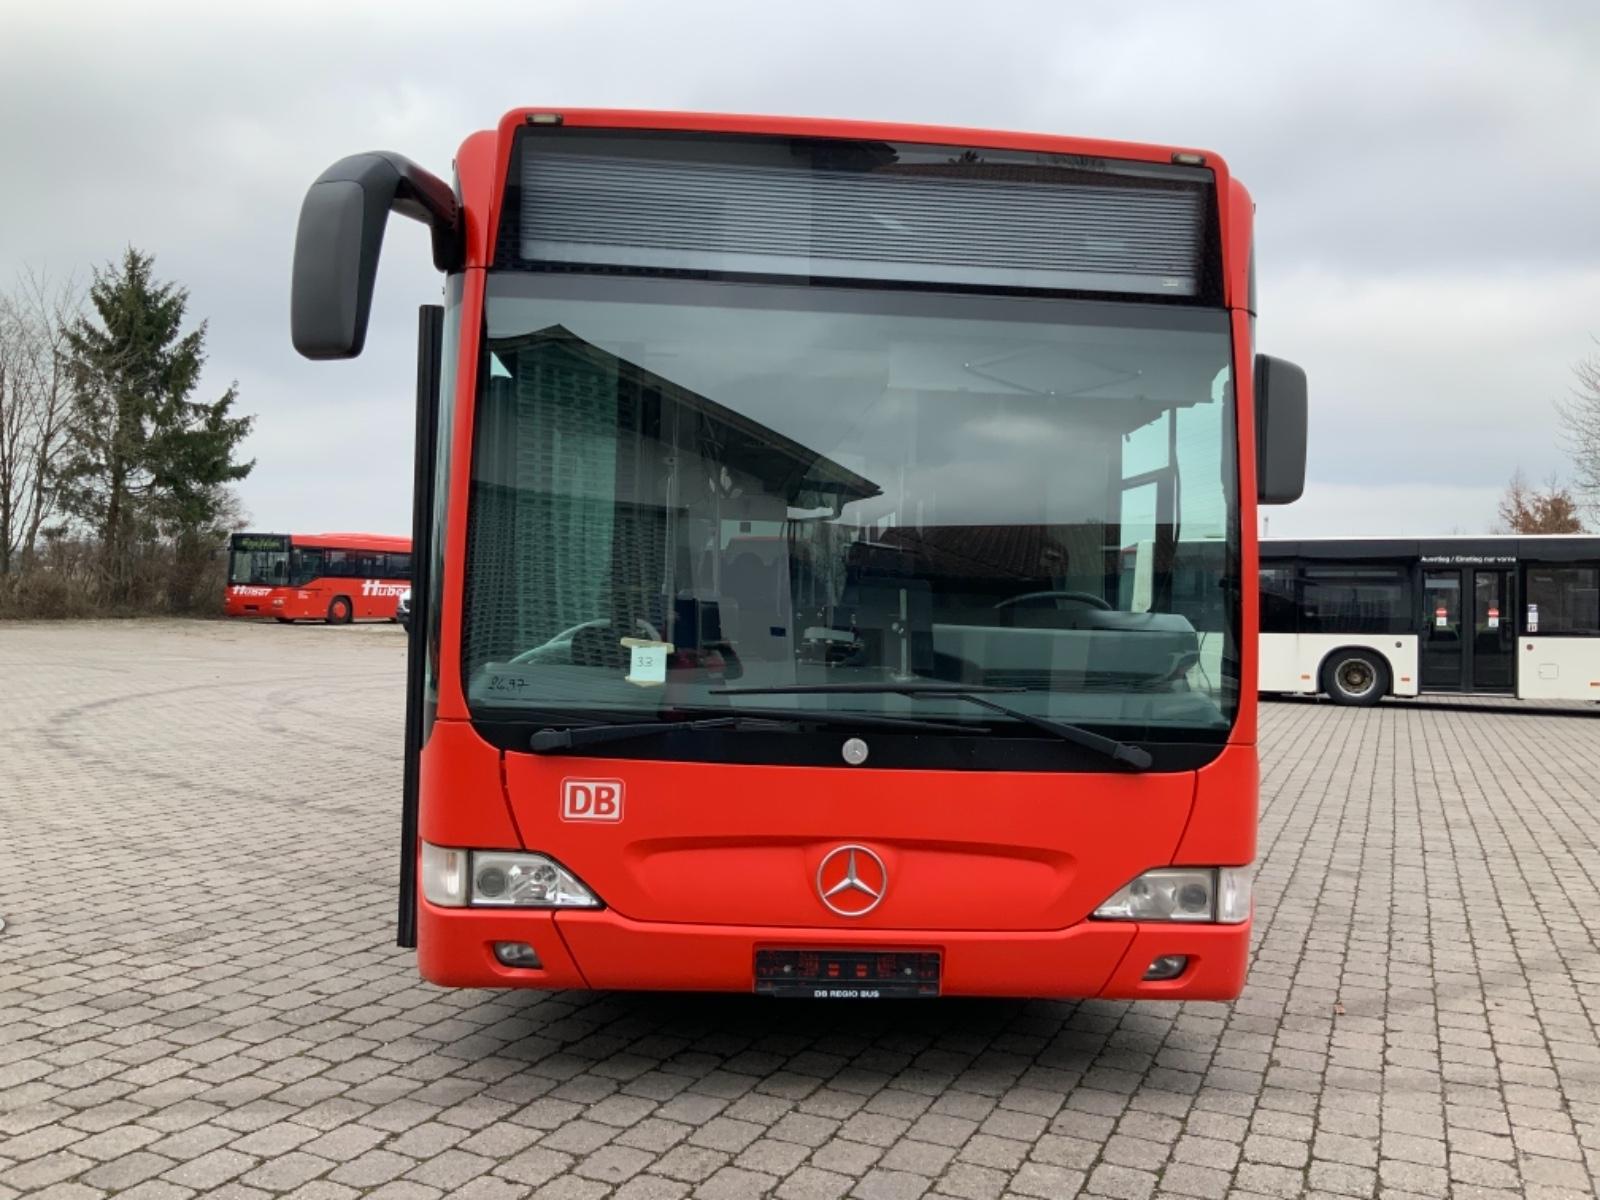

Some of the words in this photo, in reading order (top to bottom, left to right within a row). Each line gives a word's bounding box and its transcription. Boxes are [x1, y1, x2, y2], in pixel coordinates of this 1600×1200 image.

[569, 784, 617, 816] DB
[814, 989, 828, 998] DB
[829, 989, 858, 998] REGIO
[859, 989, 880, 998] BUS
